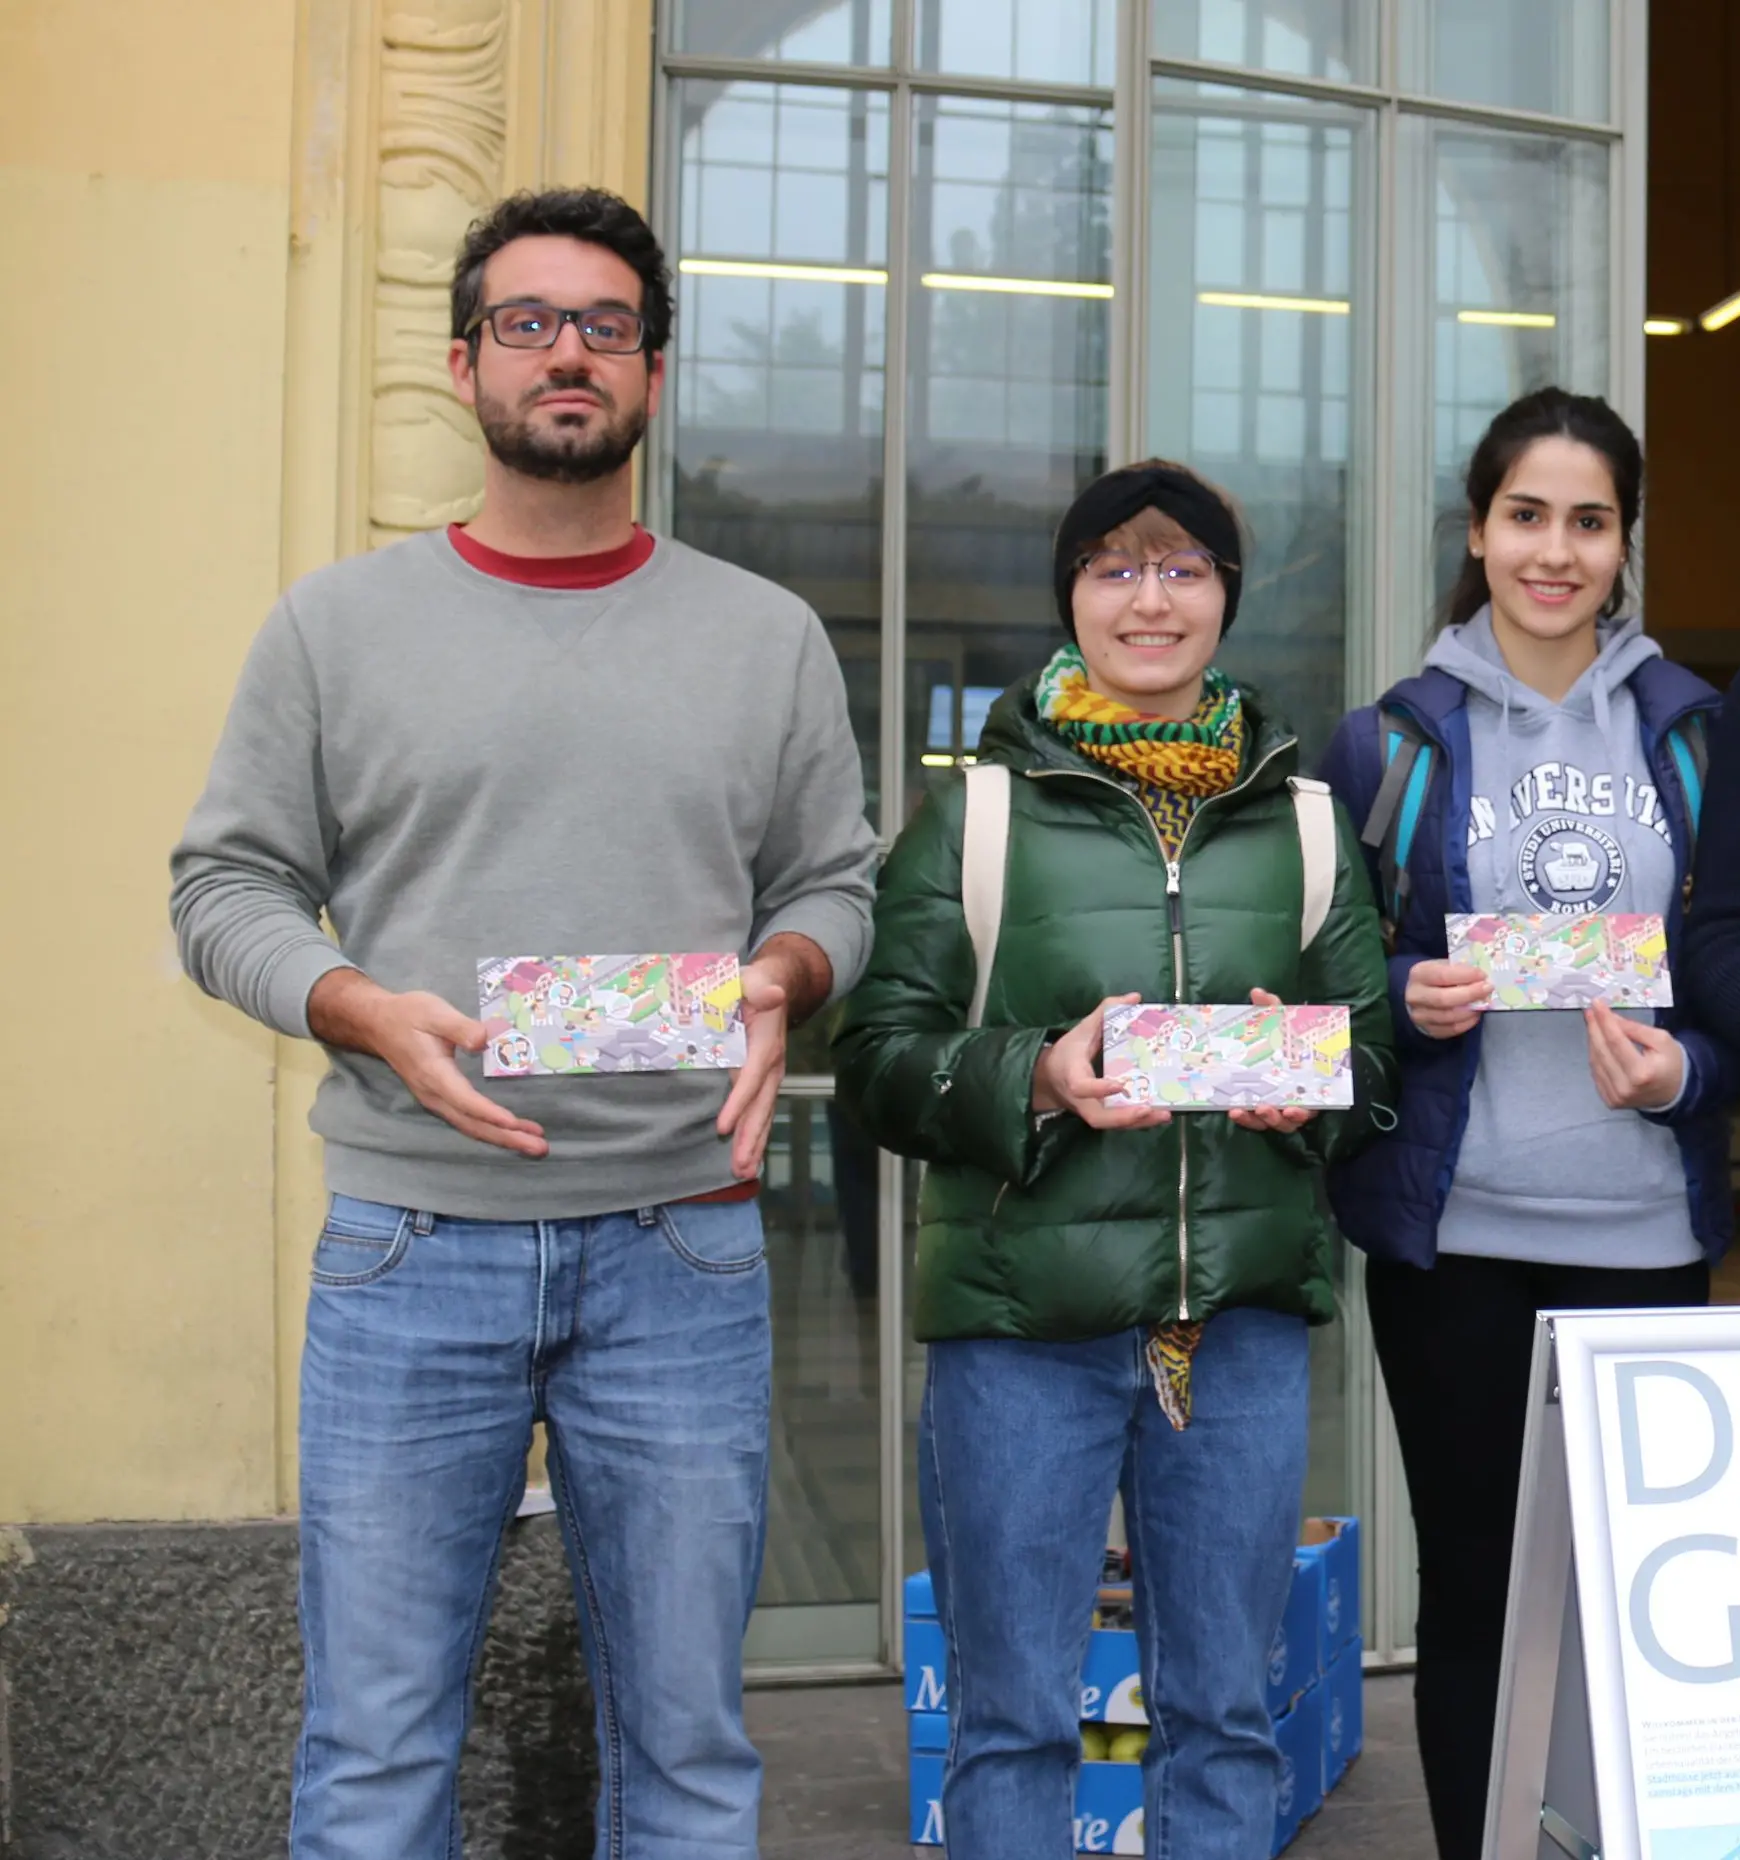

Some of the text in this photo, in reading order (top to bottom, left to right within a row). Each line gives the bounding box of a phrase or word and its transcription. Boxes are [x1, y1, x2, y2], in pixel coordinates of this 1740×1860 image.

[1522, 818, 1622, 881] STUDI UNIVERSITARI
[1550, 899, 1598, 915] ROMA
